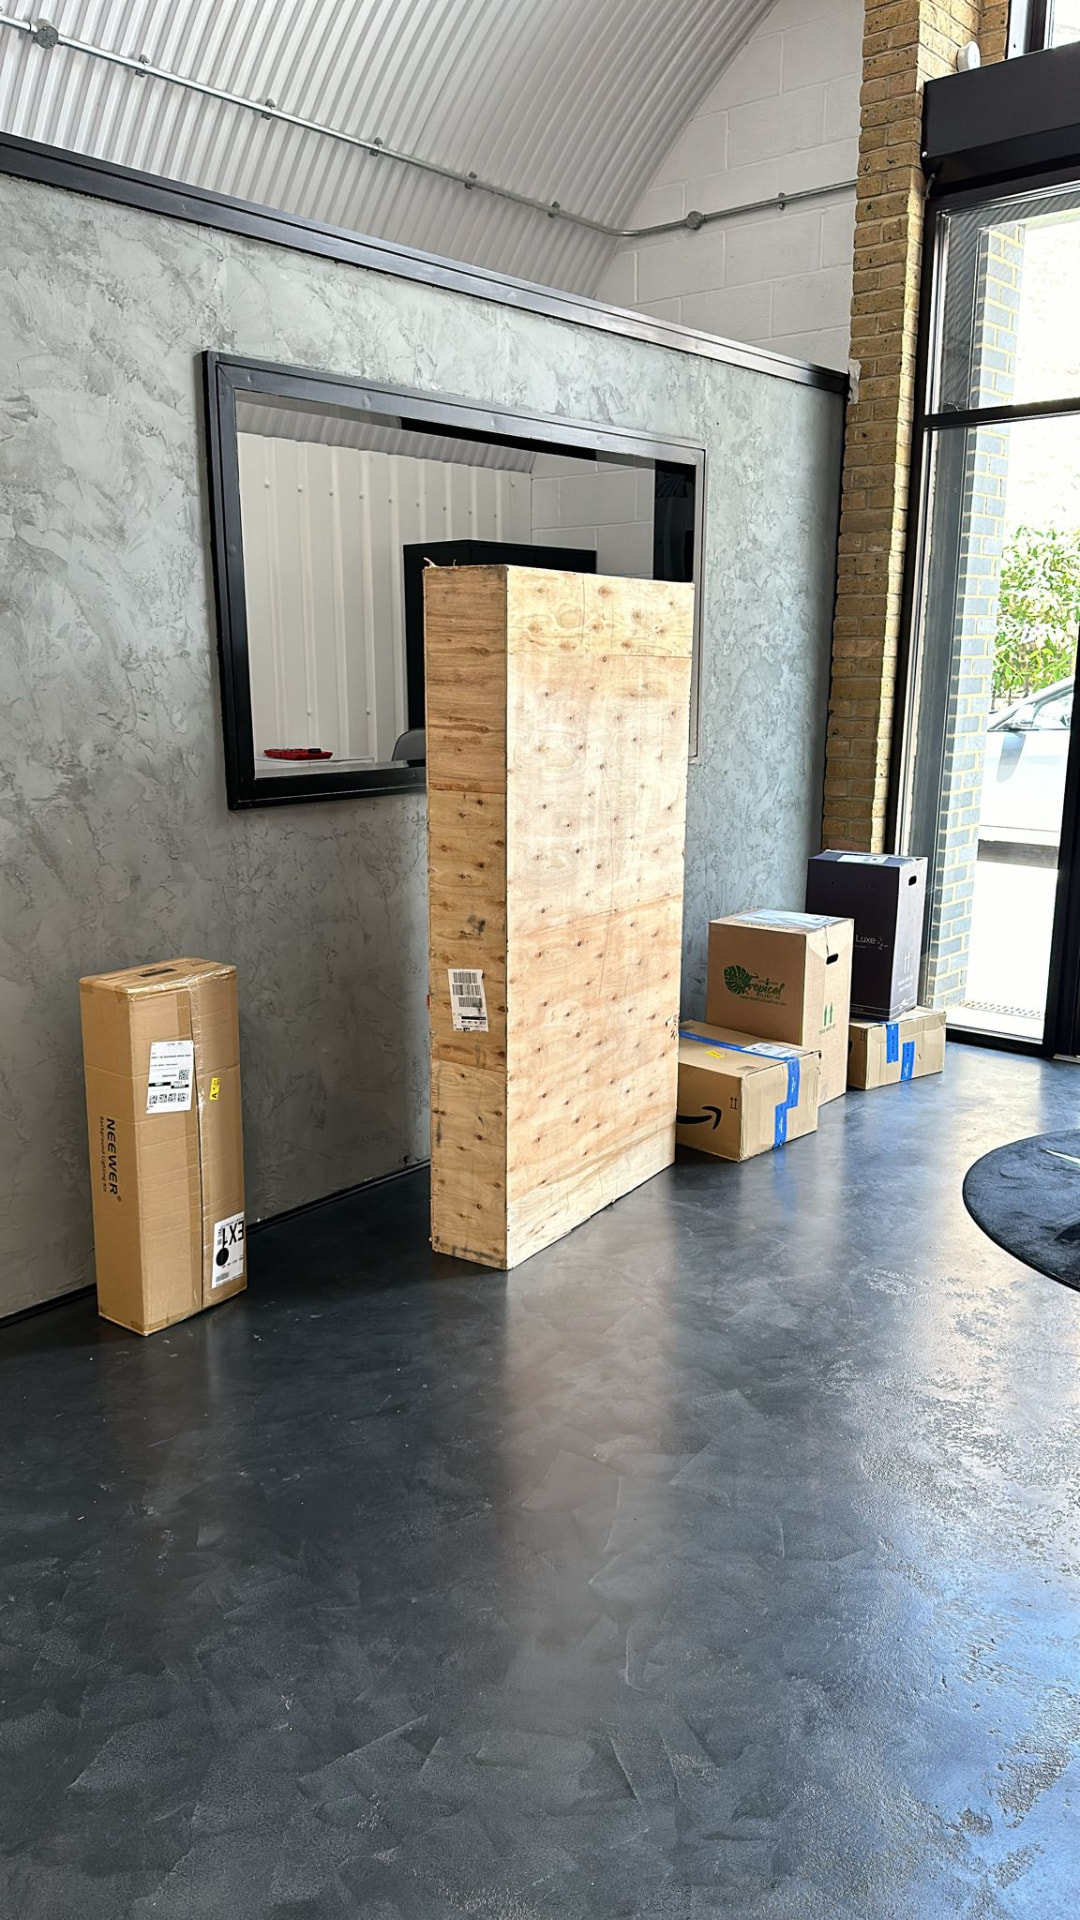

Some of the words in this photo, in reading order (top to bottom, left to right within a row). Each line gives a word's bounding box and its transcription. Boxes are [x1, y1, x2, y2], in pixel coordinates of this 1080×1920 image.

[856, 934, 876, 944] Luxe
[106, 1118, 118, 1195] NEEWER
[222, 1221, 244, 1247] EX1
